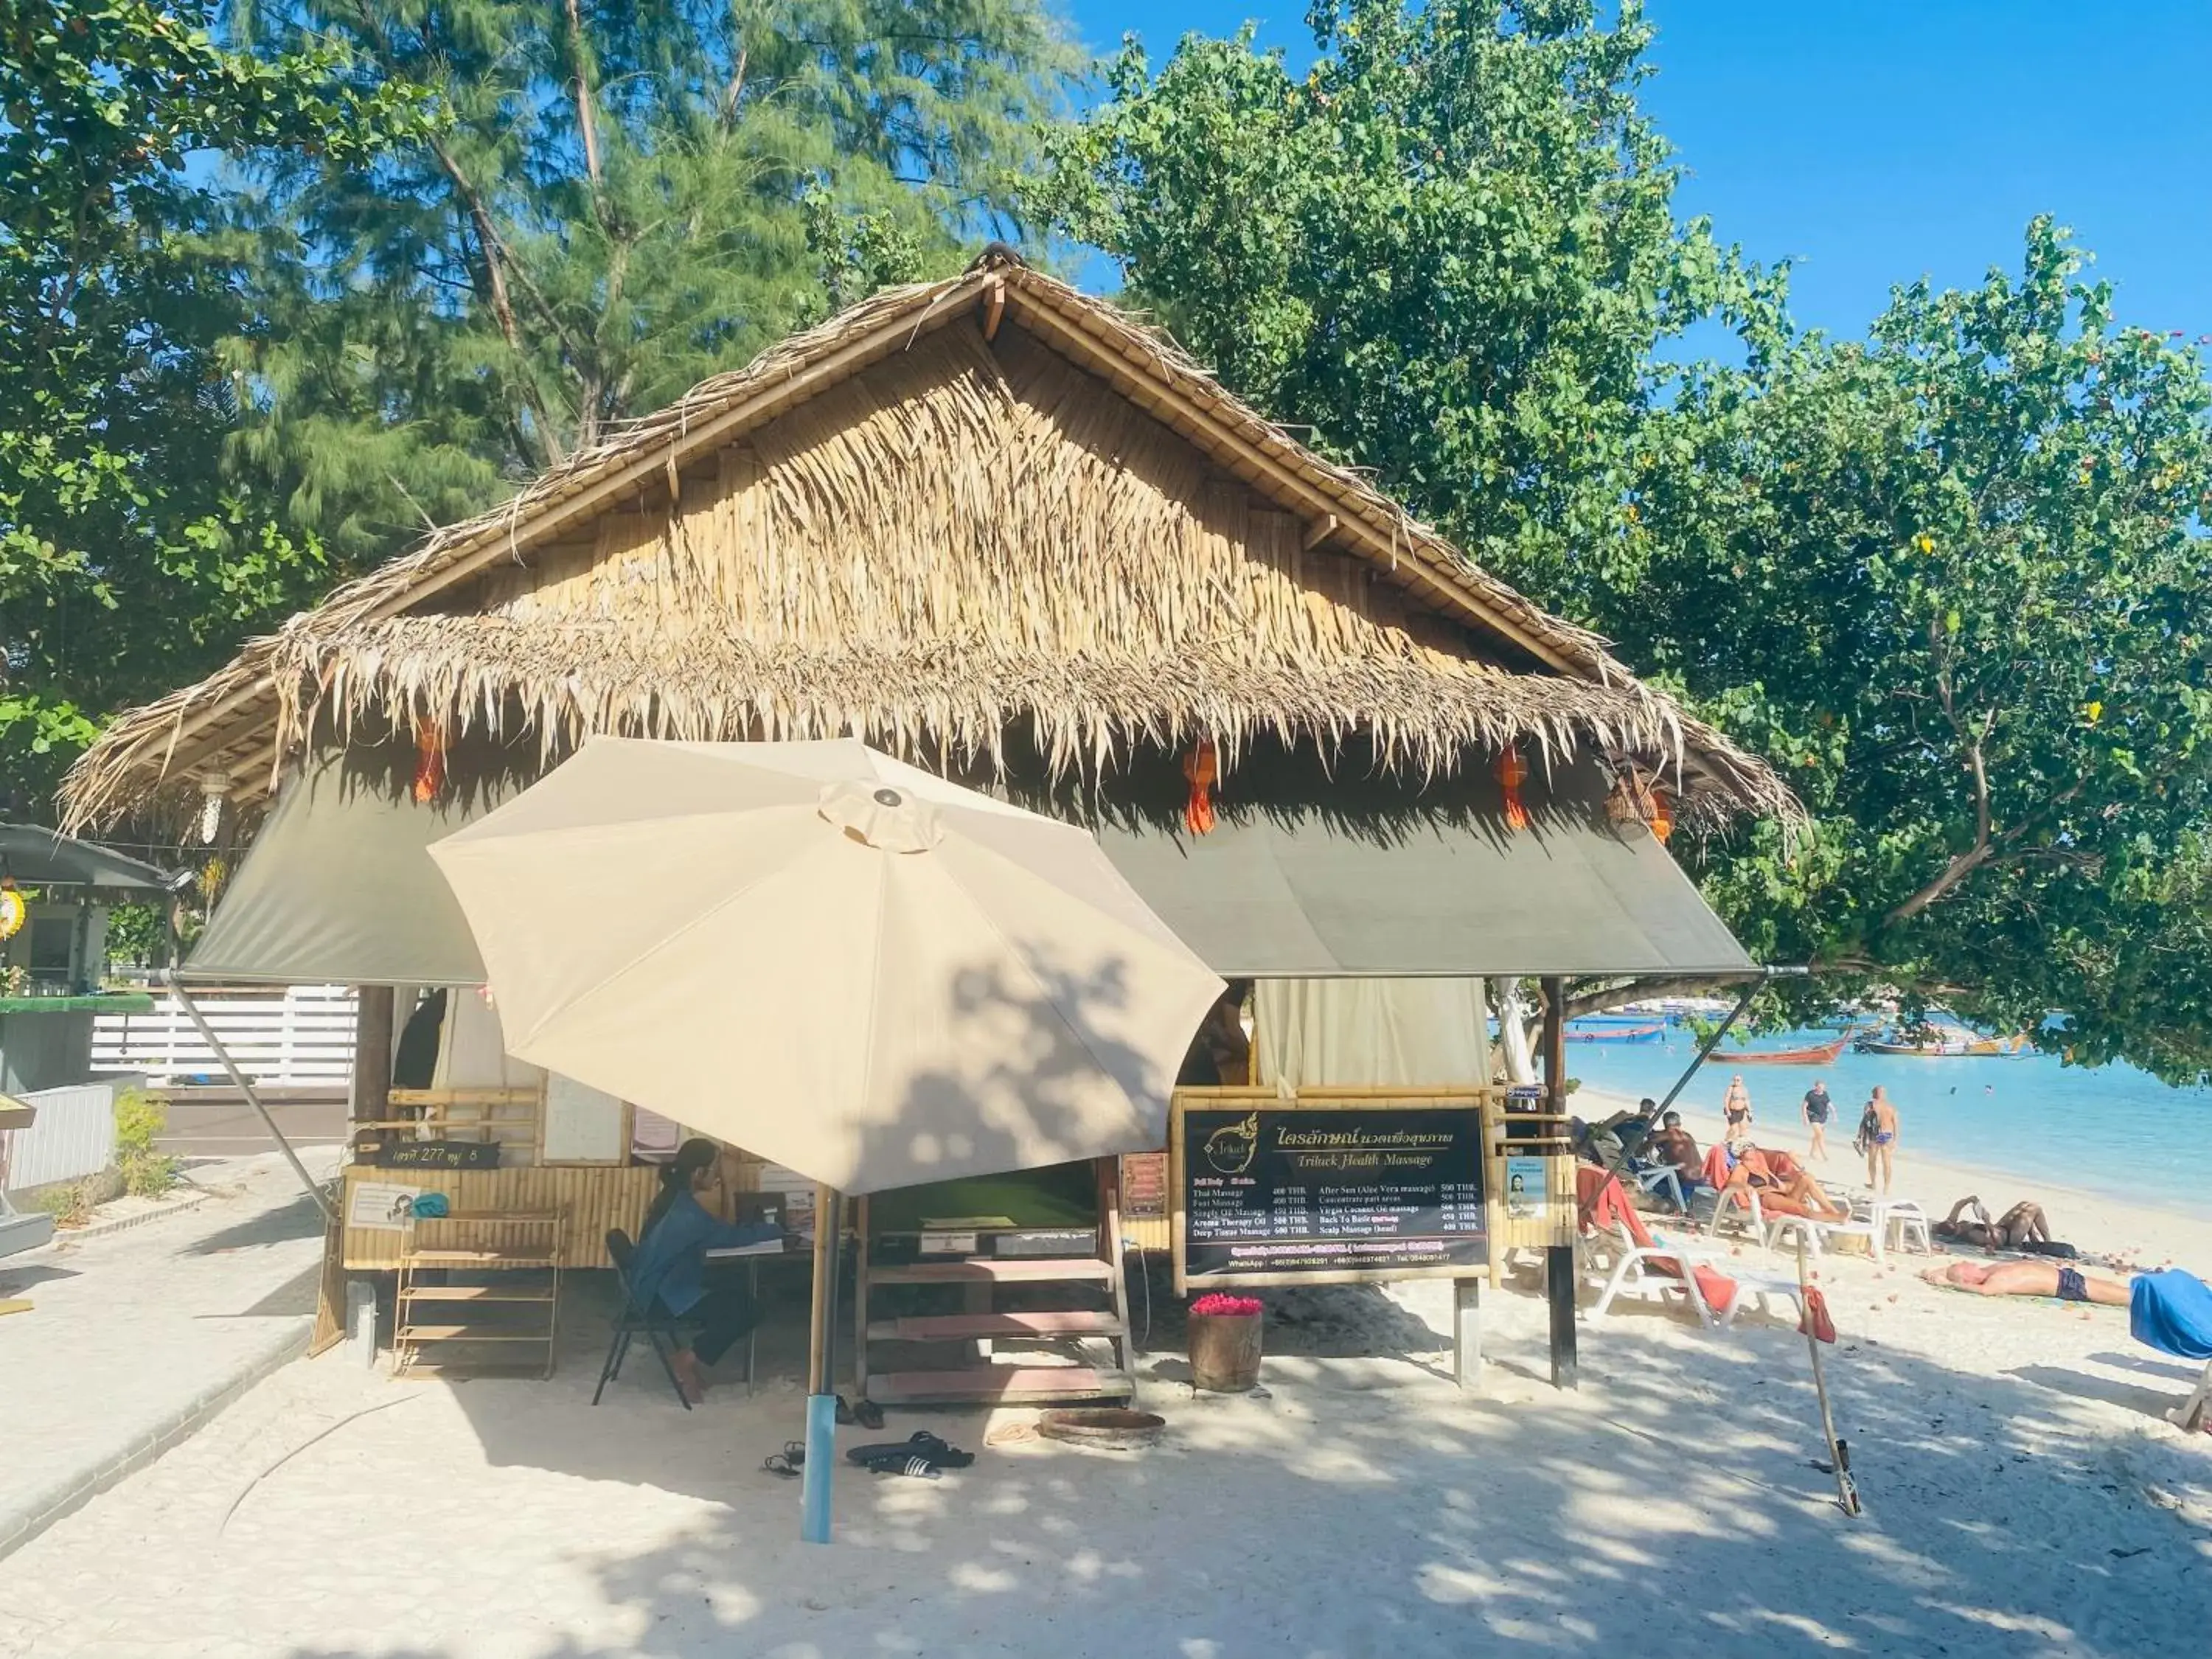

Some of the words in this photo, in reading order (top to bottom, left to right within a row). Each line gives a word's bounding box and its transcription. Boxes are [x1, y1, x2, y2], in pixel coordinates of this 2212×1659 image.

[421, 1148, 445, 1161] 277
[1297, 1155, 1338, 1168] Triluck
[1338, 1154, 1380, 1170] Health
[1383, 1153, 1433, 1169] Massage
[1340, 1186, 1356, 1194] Sun
